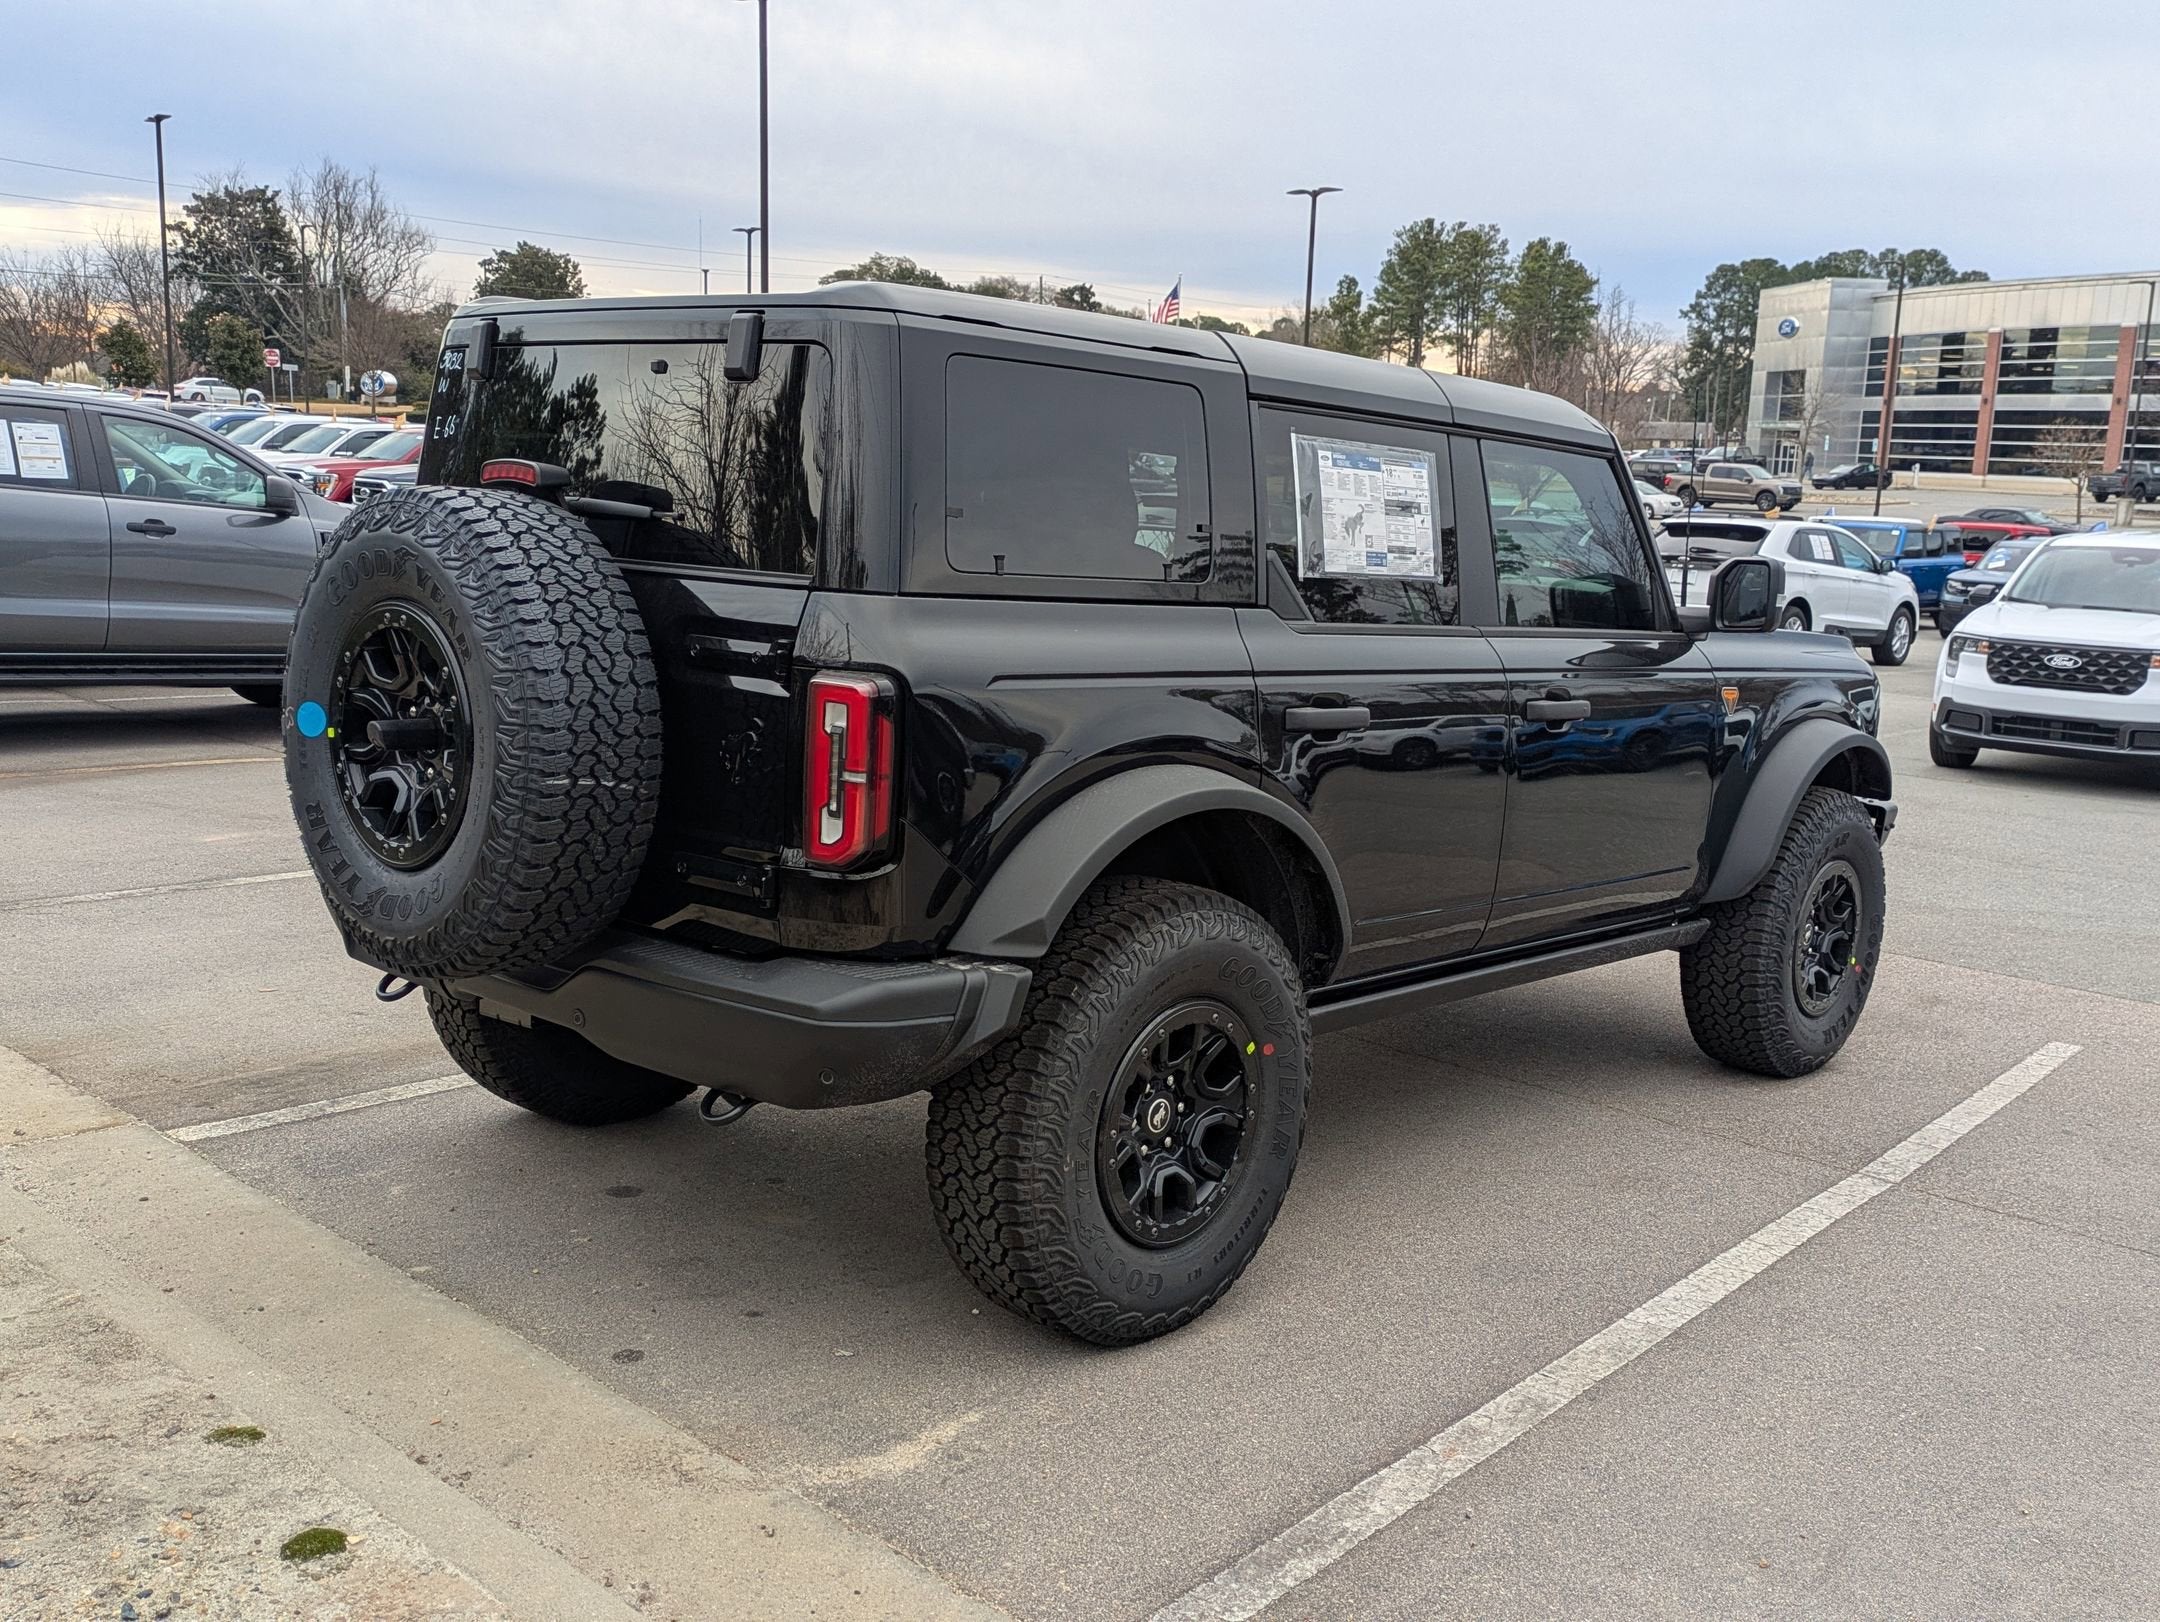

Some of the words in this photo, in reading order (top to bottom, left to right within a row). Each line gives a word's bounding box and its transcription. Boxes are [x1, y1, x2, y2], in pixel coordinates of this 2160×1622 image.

[326, 545, 472, 665] GOODYEAR
[2049, 655, 2076, 667] Ford
[305, 802, 447, 921] GOODYEAR
[1219, 956, 1299, 1160] GOODYEAR
